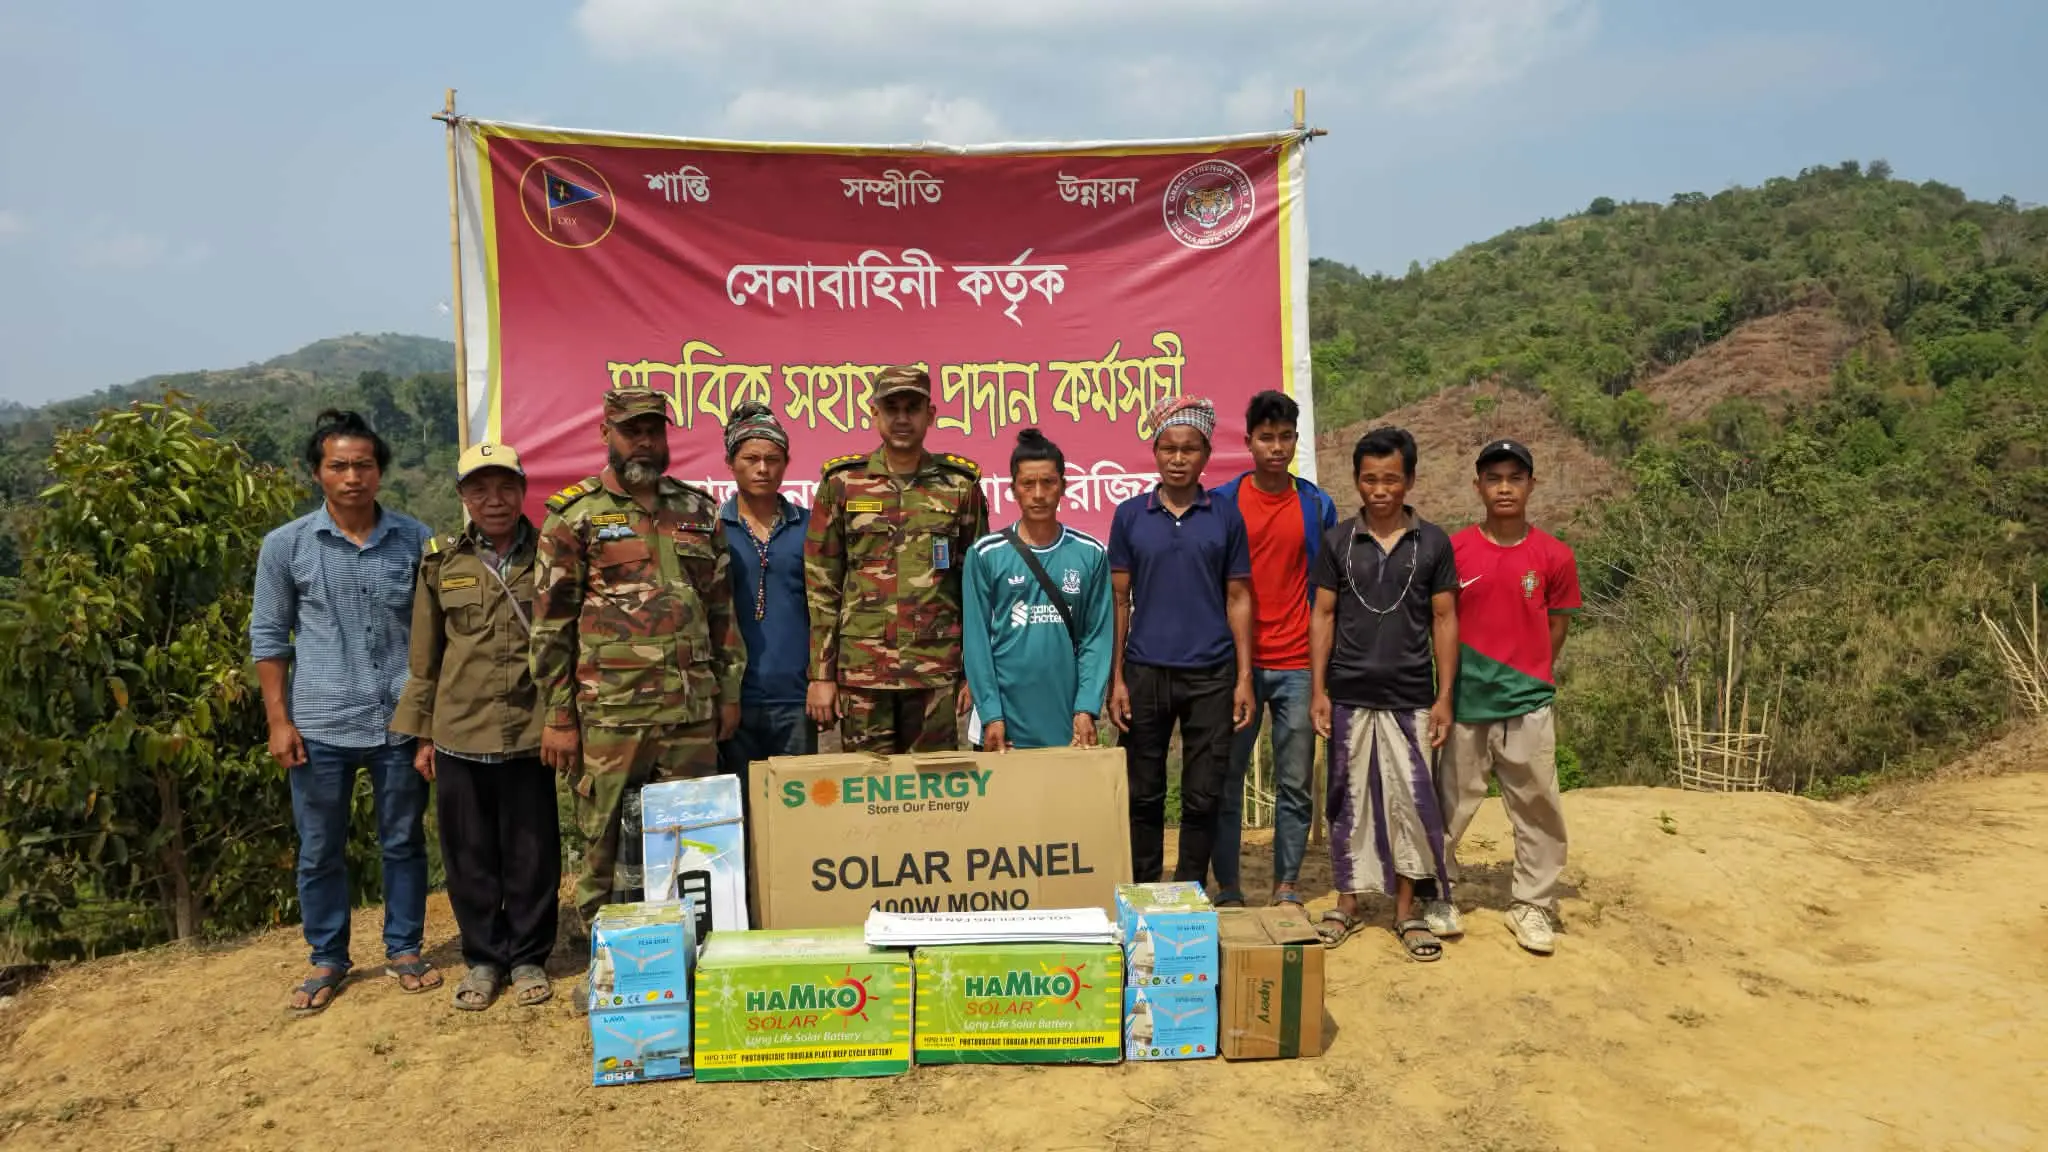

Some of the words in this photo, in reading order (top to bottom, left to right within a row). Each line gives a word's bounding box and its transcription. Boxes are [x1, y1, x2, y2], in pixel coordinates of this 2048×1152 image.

[644, 165, 710, 203] শান্তি
[840, 169, 944, 211] সম্প্রীতি
[1057, 170, 1140, 209] উন্নয়ন
[726, 248, 944, 309] সেনাবাহিনী
[952, 247, 1068, 327] কর্তৃক
[936, 361, 1040, 438] প্রদান
[481, 445, 493, 457] C
[867, 802, 900, 815] Store
[903, 801, 924, 813] Our
[928, 800, 970, 813] Energy
[811, 850, 953, 891] SOLAR
[966, 842, 1095, 882] PANEL
[871, 895, 941, 914] 100W
[947, 888, 1030, 913] MONO
[964, 970, 1073, 998] HAMKO
[745, 983, 858, 1013] HAMKO
[965, 1000, 1035, 1016] SOLAR
[746, 1014, 819, 1032] SOLAR
[964, 1020, 989, 1031] Long
[1011, 1019, 1037, 1029] Solar
[1038, 1018, 1074, 1030] Battery
[745, 1035, 772, 1046] Long
[774, 1033, 793, 1044] Life
[795, 1031, 821, 1042] Solar
[823, 1031, 861, 1042] Battery
